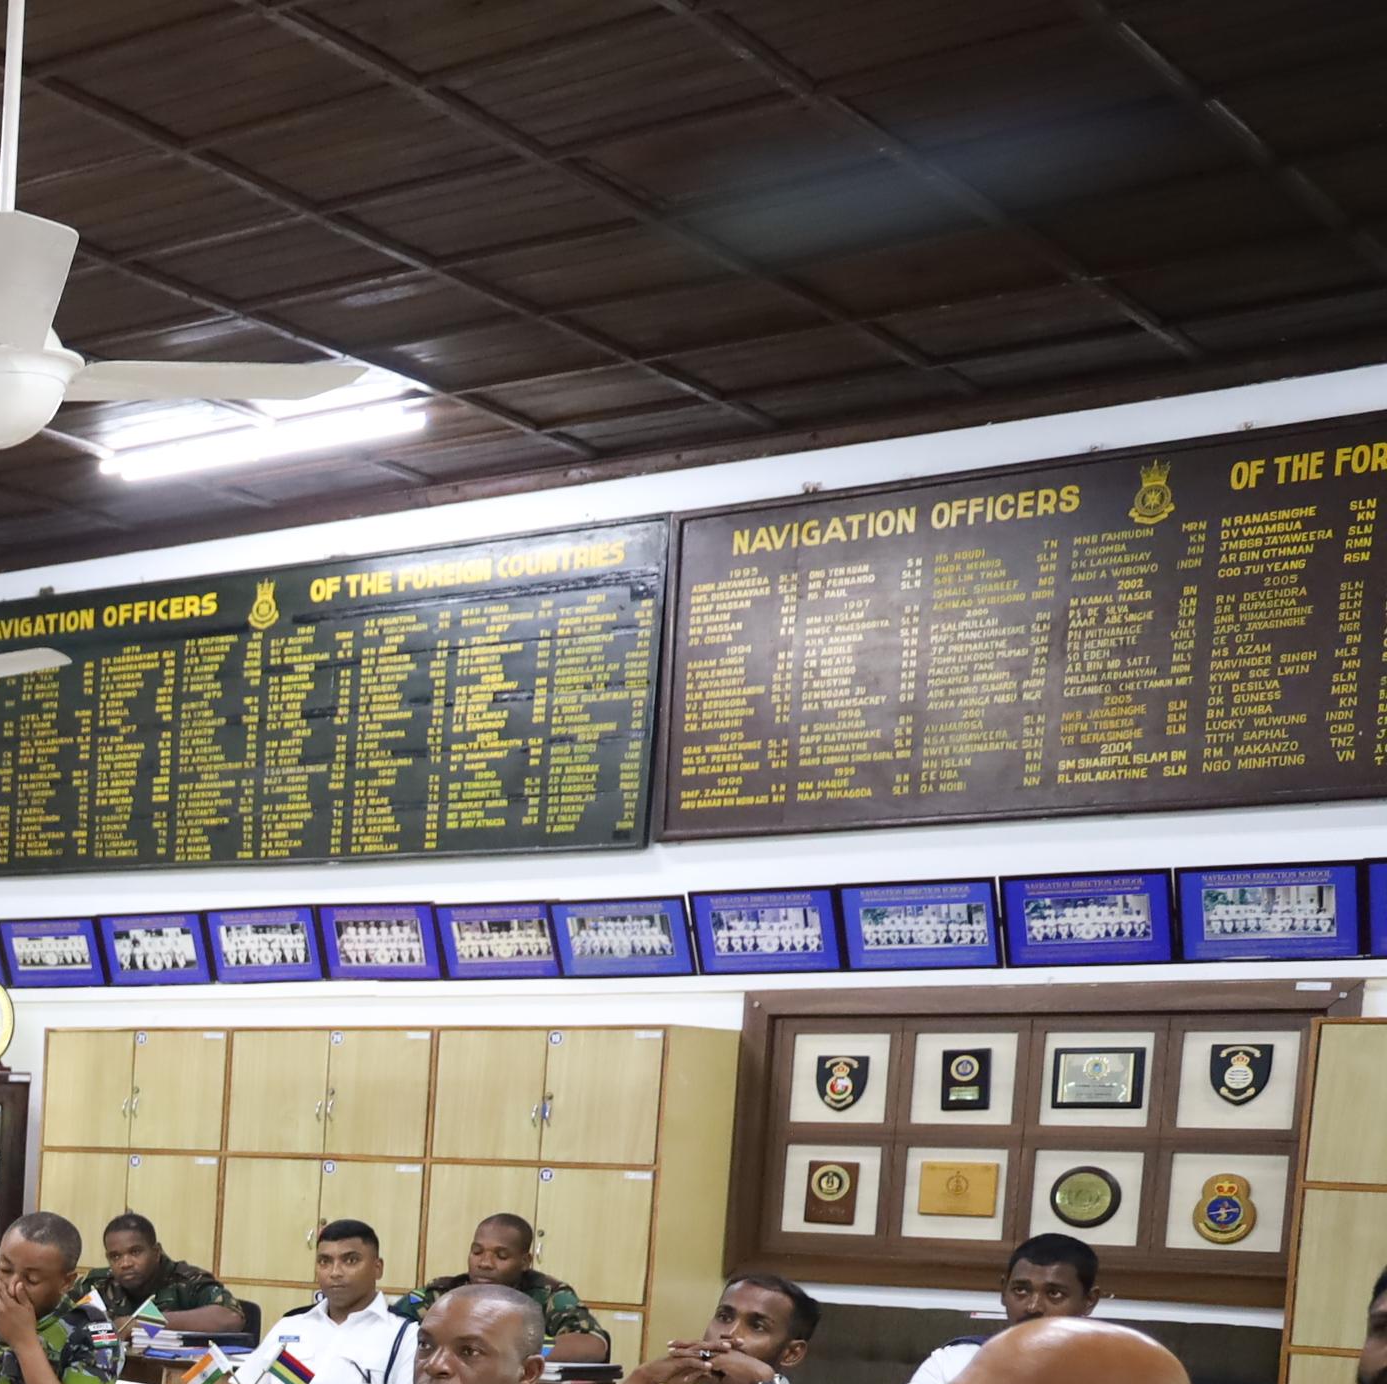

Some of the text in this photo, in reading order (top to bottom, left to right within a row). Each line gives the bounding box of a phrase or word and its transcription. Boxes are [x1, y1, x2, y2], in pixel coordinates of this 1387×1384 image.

[733, 506, 917, 557] NAVIGATION
[930, 485, 1081, 531] OFFICERS
[1230, 461, 1267, 491] OF
[1274, 450, 1323, 485] THE
[1221, 498, 1376, 527] N RANASINGHE SLN
[1242, 520, 1301, 537] WAMBUA
[1356, 510, 1375, 521] KN
[1264, 523, 1372, 546] JAYAWEERA SLN
[1239, 550, 1259, 561] BIN
[1262, 543, 1313, 559] OTHMAN
[1345, 536, 1371, 549] RMN
[310, 540, 625, 603] OF THE FOREIGN COUNTRIES
[1243, 564, 1263, 575] JUI
[1266, 558, 1306, 572] YEANG
[1343, 551, 1369, 563] RSN
[1243, 586, 1306, 602] DEVENDRA
[1339, 580, 1363, 591] SLN
[1263, 574, 1297, 586] 2005
[1338, 599, 1361, 610] SLN
[1339, 590, 1362, 601] SLN
[106, 592, 219, 629] OFFICERS
[1245, 616, 1306, 631] JAYASINGHE
[1338, 609, 1360, 620] SLN
[1338, 621, 1360, 632] NGR
[1211, 633, 1361, 657] MS AZAM BN
[1210, 646, 1358, 670] PARVINDER SINGH MLS
[1209, 670, 1239, 682] KYAW
[1277, 664, 1309, 675] LWIN
[1342, 658, 1360, 669] MN
[1231, 679, 1279, 692] DESILVA
[1332, 671, 1356, 682] SLN
[1233, 690, 1281, 704] GUNESS
[1330, 683, 1357, 694] MRN
[1206, 695, 1357, 719] BN KUMBA KN
[1205, 709, 1353, 731] LUCKY WUWUNG INDN
[1205, 722, 1354, 744] TITH SAPHAL CMD
[1100, 741, 1132, 754] 2004
[1203, 735, 1354, 758] RM MAKANZO TNZ
[1078, 754, 1130, 768] SHARIFUL
[1133, 751, 1167, 764] ISLAM
[1171, 750, 1185, 761] BN
[1202, 749, 1354, 772] NGO MINHTUNG VN
[1057, 765, 1187, 784] RL KULARATHNE SLN
[1202, 872, 1251, 882] NAVIGATION
